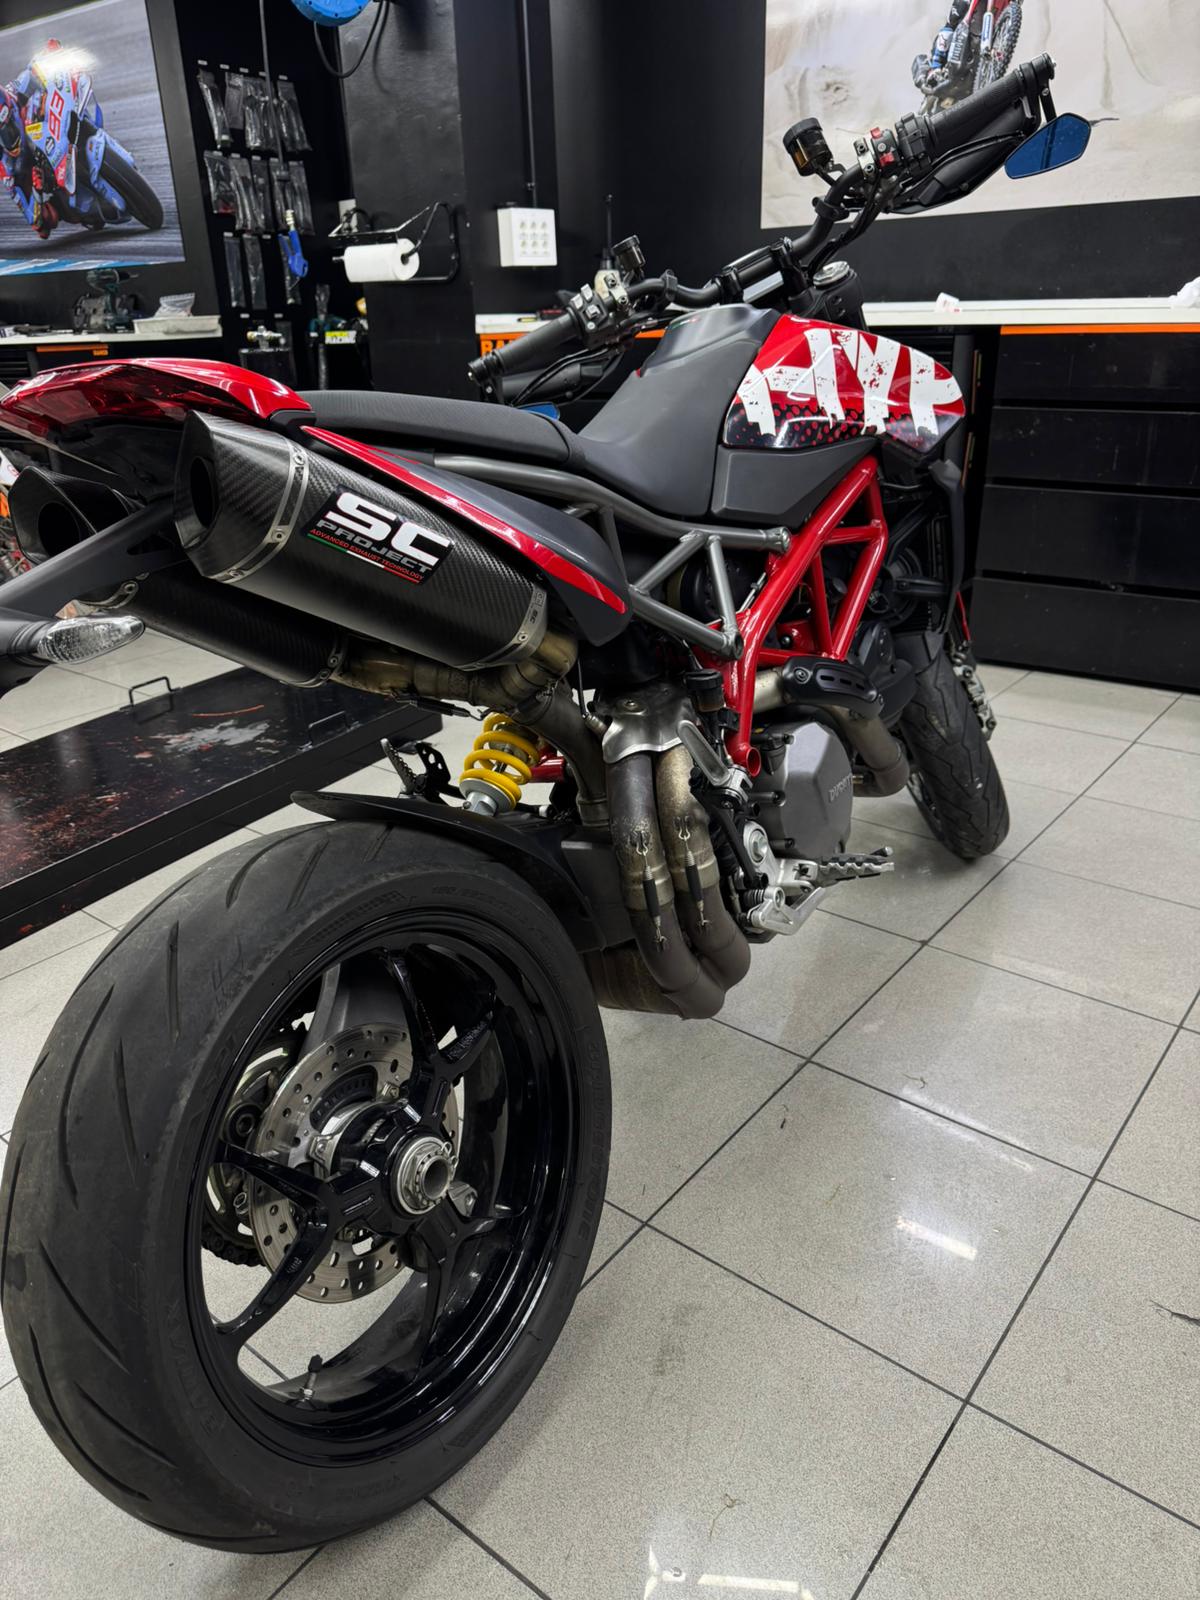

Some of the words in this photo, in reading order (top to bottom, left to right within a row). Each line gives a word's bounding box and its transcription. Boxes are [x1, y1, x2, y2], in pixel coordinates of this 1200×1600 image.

[310, 528, 349, 549] ADVANCED
[350, 545, 381, 562] EXHAUST
[382, 558, 424, 581] TECHNOLOGY
[316, 519, 433, 574] PROJECT
[324, 491, 451, 566] SC
